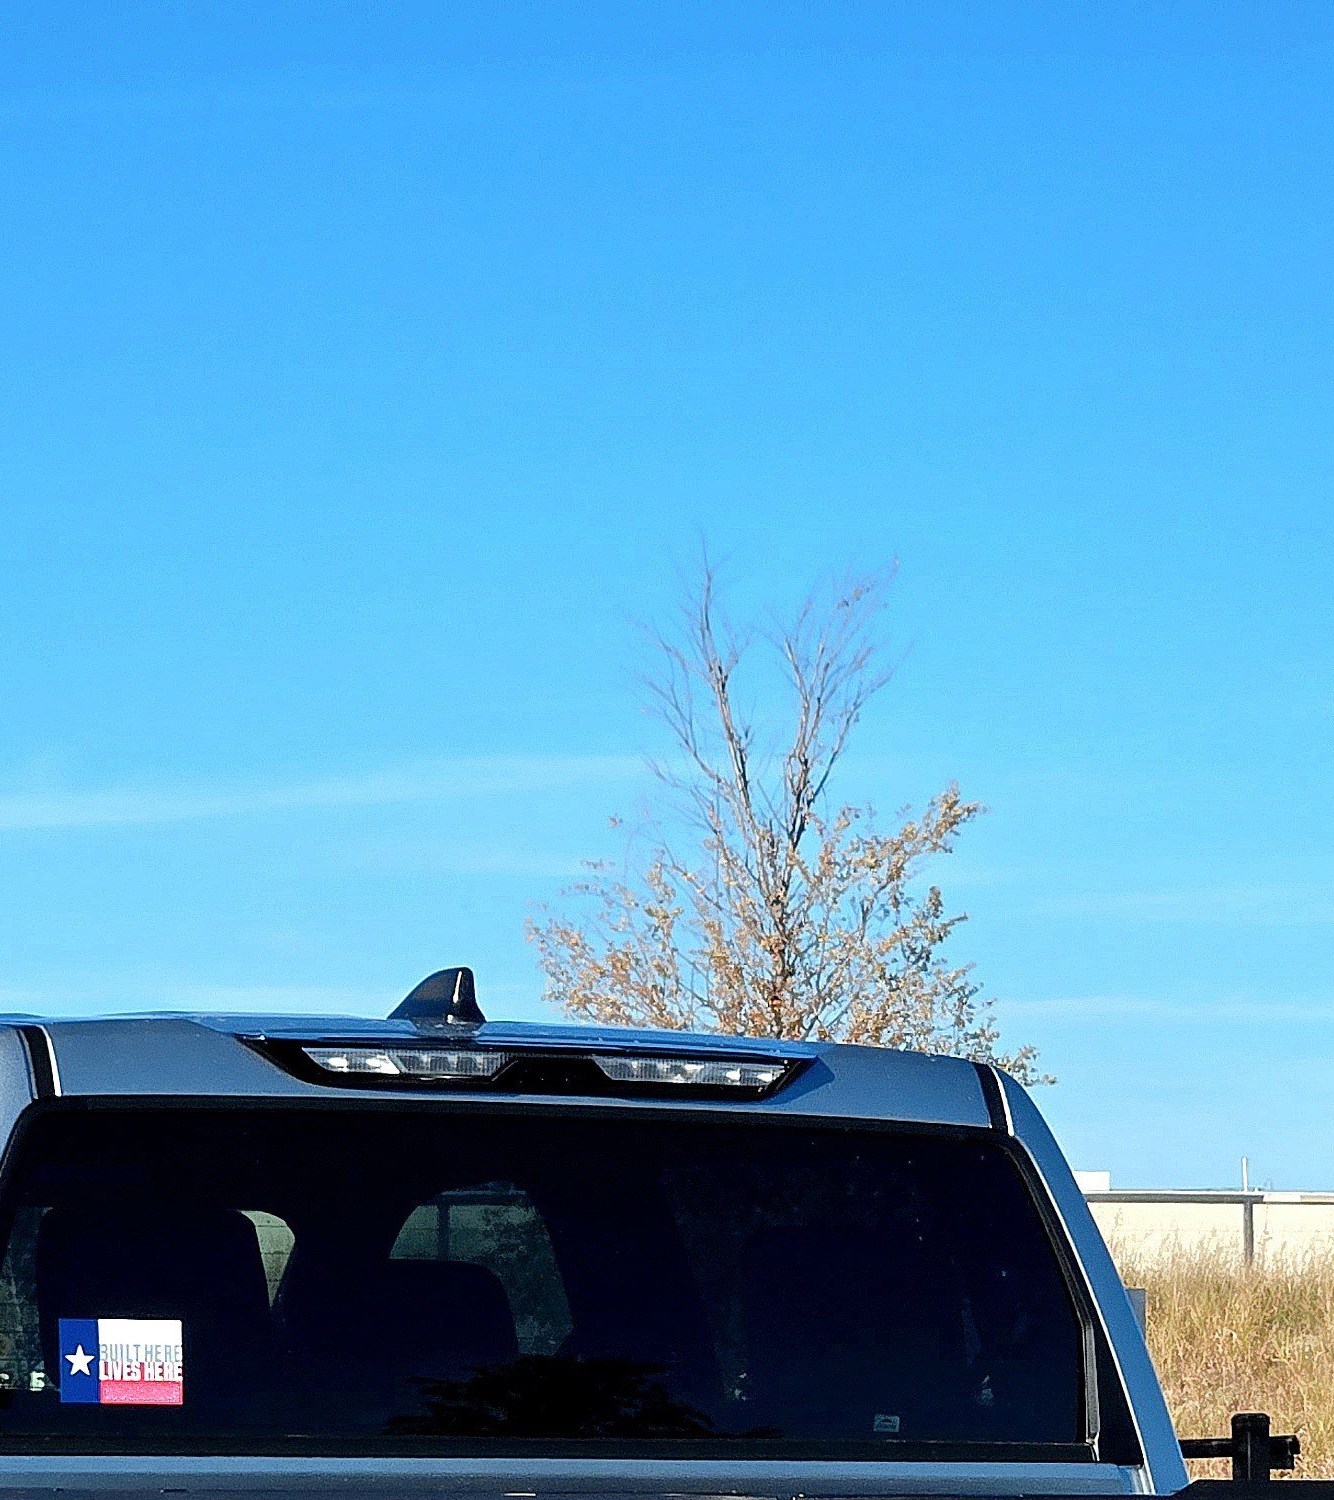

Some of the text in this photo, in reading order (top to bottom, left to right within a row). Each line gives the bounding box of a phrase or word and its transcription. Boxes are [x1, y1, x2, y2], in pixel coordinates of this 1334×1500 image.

[99, 1344, 182, 1362] BUILT HERE
[99, 1362, 183, 1381] LIVES HERE
